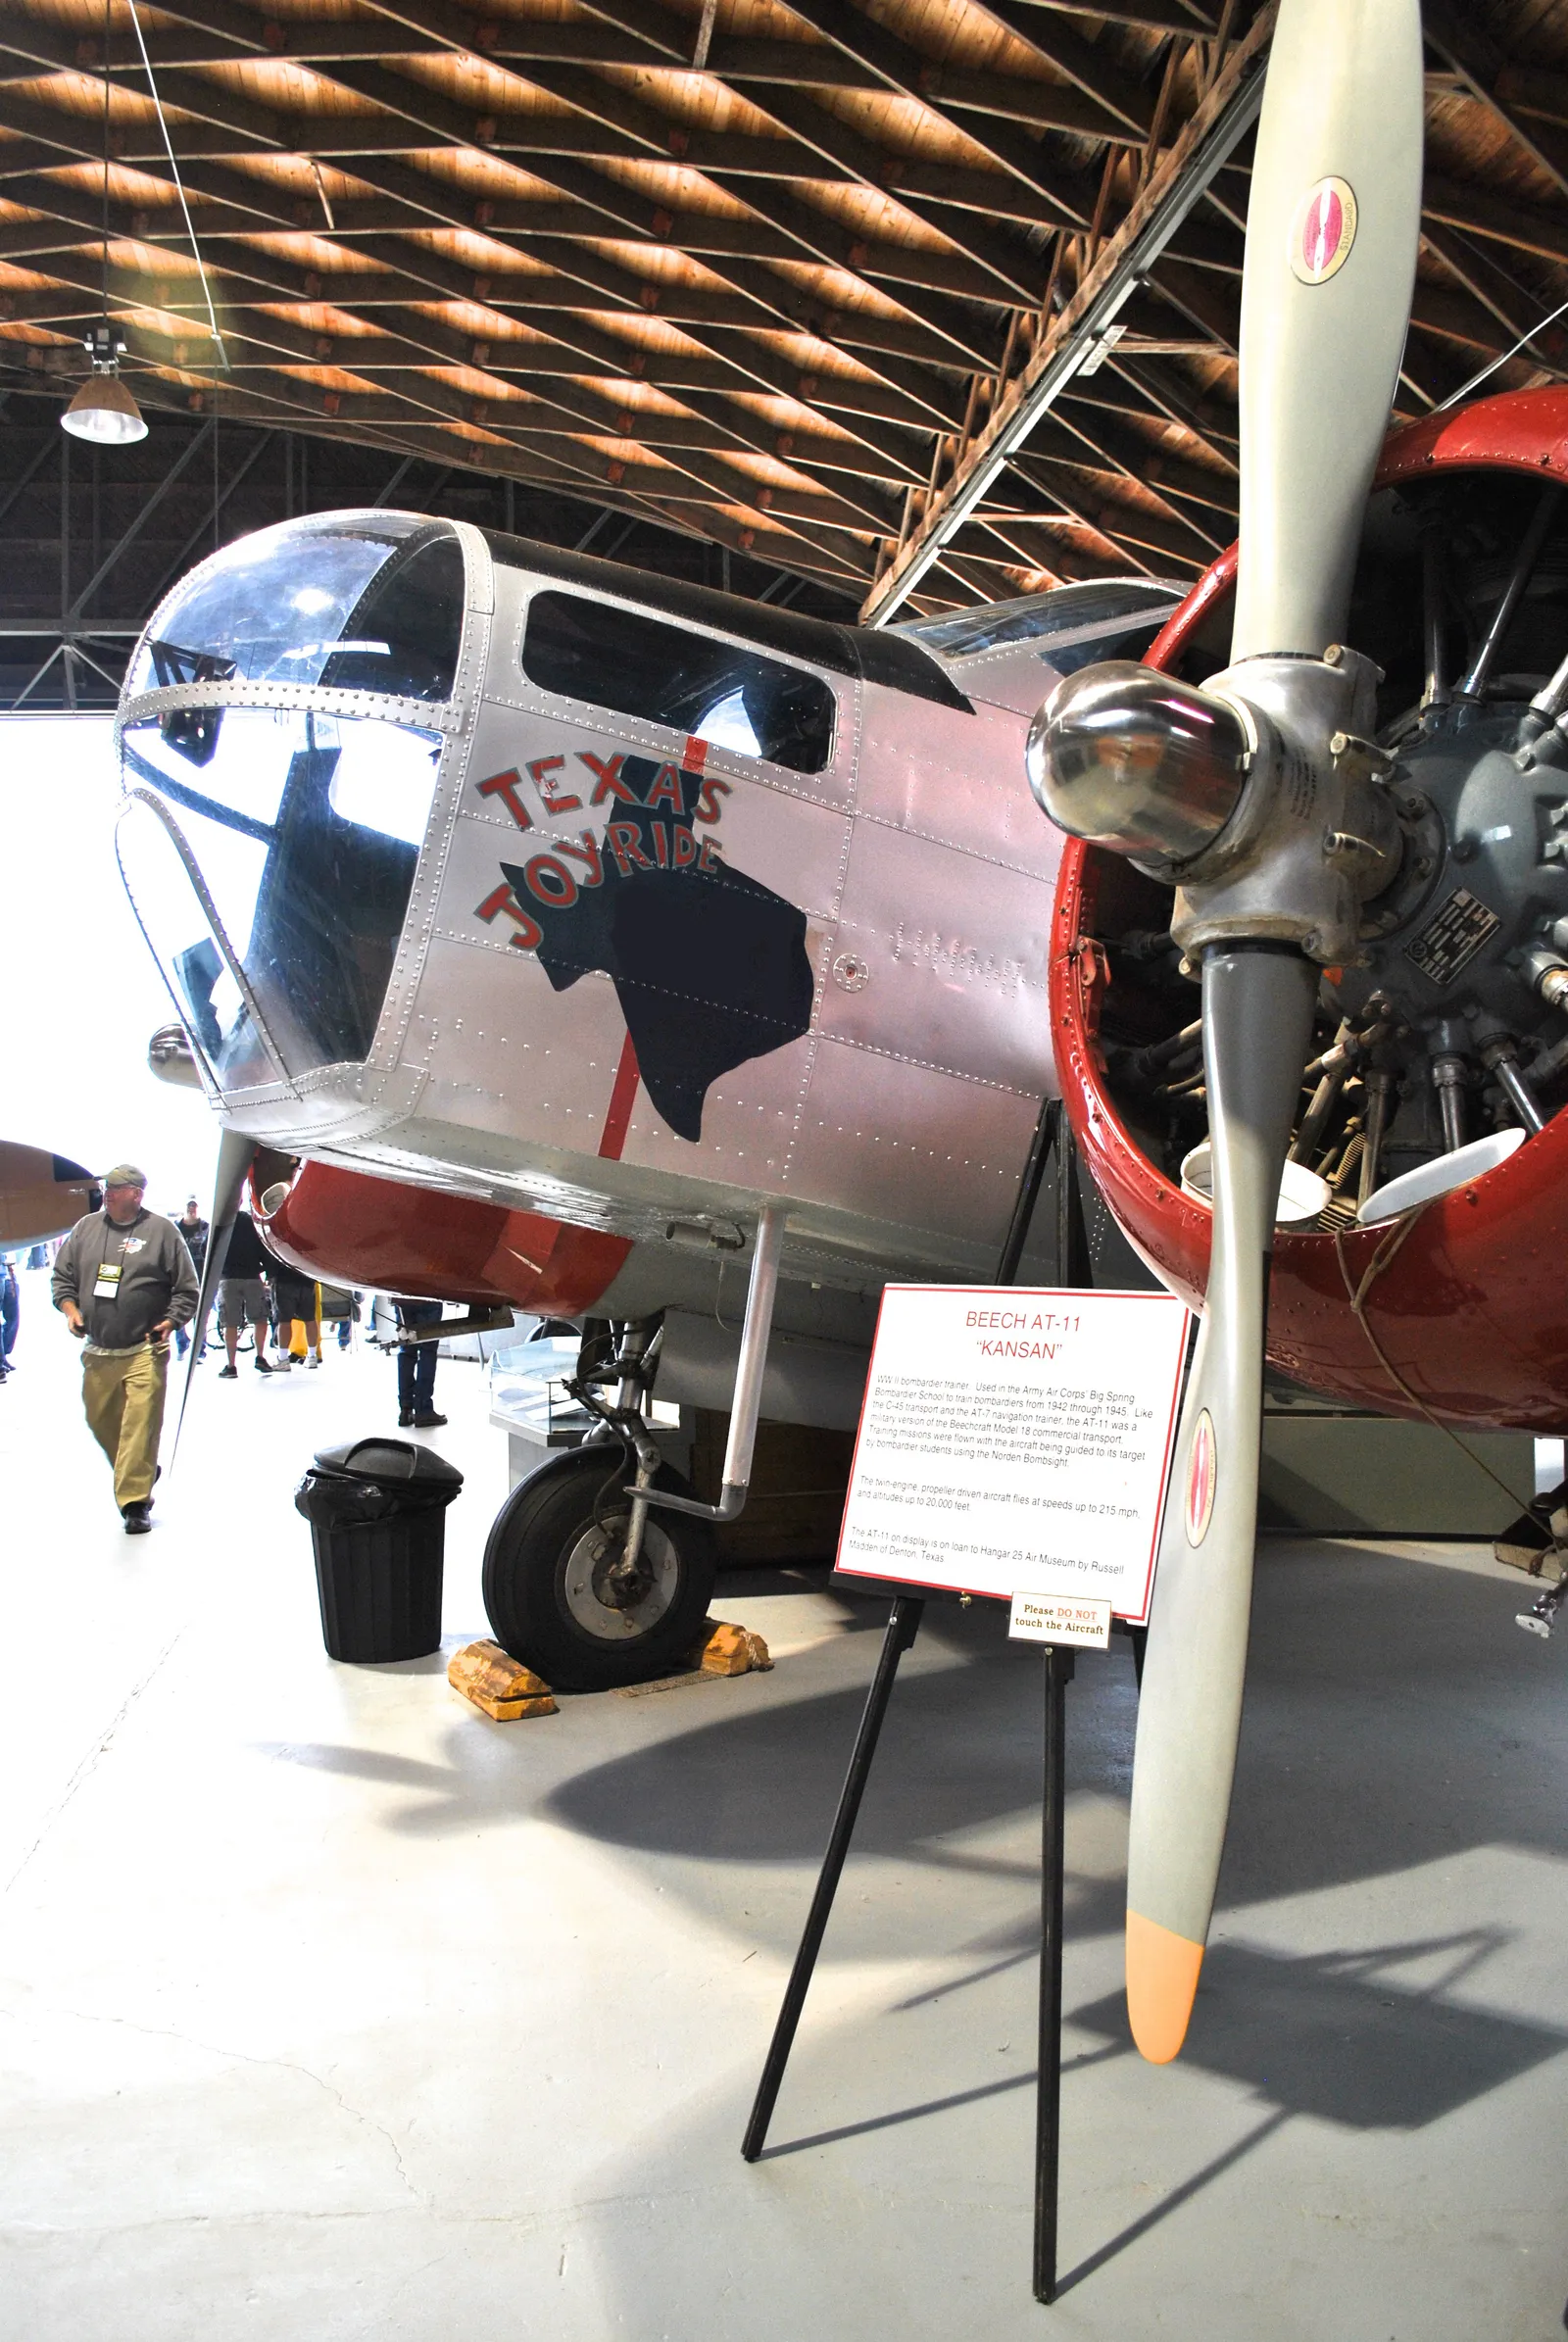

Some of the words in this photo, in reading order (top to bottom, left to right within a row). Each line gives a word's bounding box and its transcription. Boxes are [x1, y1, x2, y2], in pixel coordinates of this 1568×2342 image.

[474, 751, 733, 831] TEXAS
[473, 821, 723, 951] JOYRIDE
[965, 1310, 1027, 1330] BEECH
[1030, 1313, 1081, 1333] AT-11
[874, 1387, 917, 1399] Bombardier
[918, 1390, 946, 1401] School
[946, 1393, 955, 1402] to
[955, 1394, 973, 1403] train
[973, 1395, 1024, 1408] bombardiers
[1025, 1398, 1045, 1409] from
[1048, 1400, 1068, 1412] 1942
[1069, 1402, 1102, 1417] through
[1134, 1407, 1153, 1419] Like
[877, 1375, 894, 1385] WW
[900, 1377, 944, 1389] bombardier
[975, 1382, 998, 1392] Used
[1006, 1384, 1021, 1394] the
[1021, 1385, 1045, 1398] Army
[1046, 1387, 1058, 1396] Air
[1089, 1390, 1104, 1403] Big
[1105, 1391, 1136, 1406] Spring
[870, 1413, 897, 1426] military
[898, 1416, 925, 1426] version
[925, 1417, 935, 1427] of
[935, 1419, 949, 1429] the
[949, 1418, 992, 1433] Beechcraft
[993, 1423, 1019, 1435] Model
[1021, 1426, 1031, 1437] 18
[1032, 1428, 1082, 1440] commercial
[872, 1400, 885, 1409] the
[885, 1399, 905, 1411] C-45
[905, 1403, 939, 1415] transport
[939, 1406, 956, 1416] and
[956, 1406, 969, 1417] the
[970, 1407, 991, 1419] AT-7
[992, 1411, 1034, 1424] navigation
[1066, 1415, 1081, 1427] the
[1082, 1417, 1108, 1430] AT-11
[1111, 1421, 1129, 1432] was
[1131, 1423, 1138, 1432] a
[865, 1438, 876, 1449] by
[876, 1439, 918, 1451] bombardier
[919, 1443, 953, 1455] students
[954, 1448, 976, 1460] using
[976, 1448, 990, 1459] the
[991, 1449, 1022, 1462] Norden
[869, 1424, 899, 1439] Training
[899, 1429, 932, 1440] missions
[933, 1433, 953, 1442] were
[954, 1433, 975, 1443] flown
[976, 1436, 993, 1445] with
[994, 1438, 1008, 1447] the
[1008, 1439, 1039, 1450] aircraft
[1039, 1441, 1063, 1455] being
[1064, 1444, 1095, 1456] guided
[1096, 1447, 1105, 1457] to
[1106, 1448, 1117, 1459] its
[1119, 1449, 1146, 1463] target
[857, 1489, 872, 1499] and
[872, 1491, 905, 1503] altitudes
[905, 1496, 915, 1506] up
[916, 1496, 925, 1506] to
[860, 1475, 874, 1487] The
[920, 1485, 956, 1496] propeller
[956, 1488, 982, 1499] driven
[982, 1491, 1011, 1503] aircraft
[1012, 1492, 1030, 1505] flies
[1031, 1497, 1041, 1506] at
[1042, 1498, 1073, 1511] speeds
[1074, 1503, 1087, 1514] up
[1088, 1503, 1098, 1513] to
[1099, 1503, 1116, 1516] 215
[849, 1539, 879, 1552] Madden
[879, 1544, 888, 1554] of
[852, 1526, 865, 1537] The
[866, 1529, 889, 1540] AT-11
[891, 1534, 902, 1542] on
[902, 1535, 930, 1549] display
[930, 1539, 938, 1548] is
[939, 1540, 951, 1549] on
[951, 1541, 969, 1552] loan
[970, 1544, 979, 1554] to
[980, 1544, 1011, 1560] Hangar
[1011, 1549, 1023, 1561] 25
[1024, 1551, 1038, 1563] Air
[1038, 1553, 1076, 1568] Museum
[1077, 1559, 1090, 1573] by
[1091, 1560, 1125, 1575] Russell
[1015, 1617, 1043, 1628] touch
[1046, 1620, 1062, 1631] the
[1064, 1622, 1103, 1635] Aircraft
[1024, 1604, 1054, 1616] Please
[1057, 1607, 1073, 1618] DO
[1075, 1609, 1098, 1621] NOT
